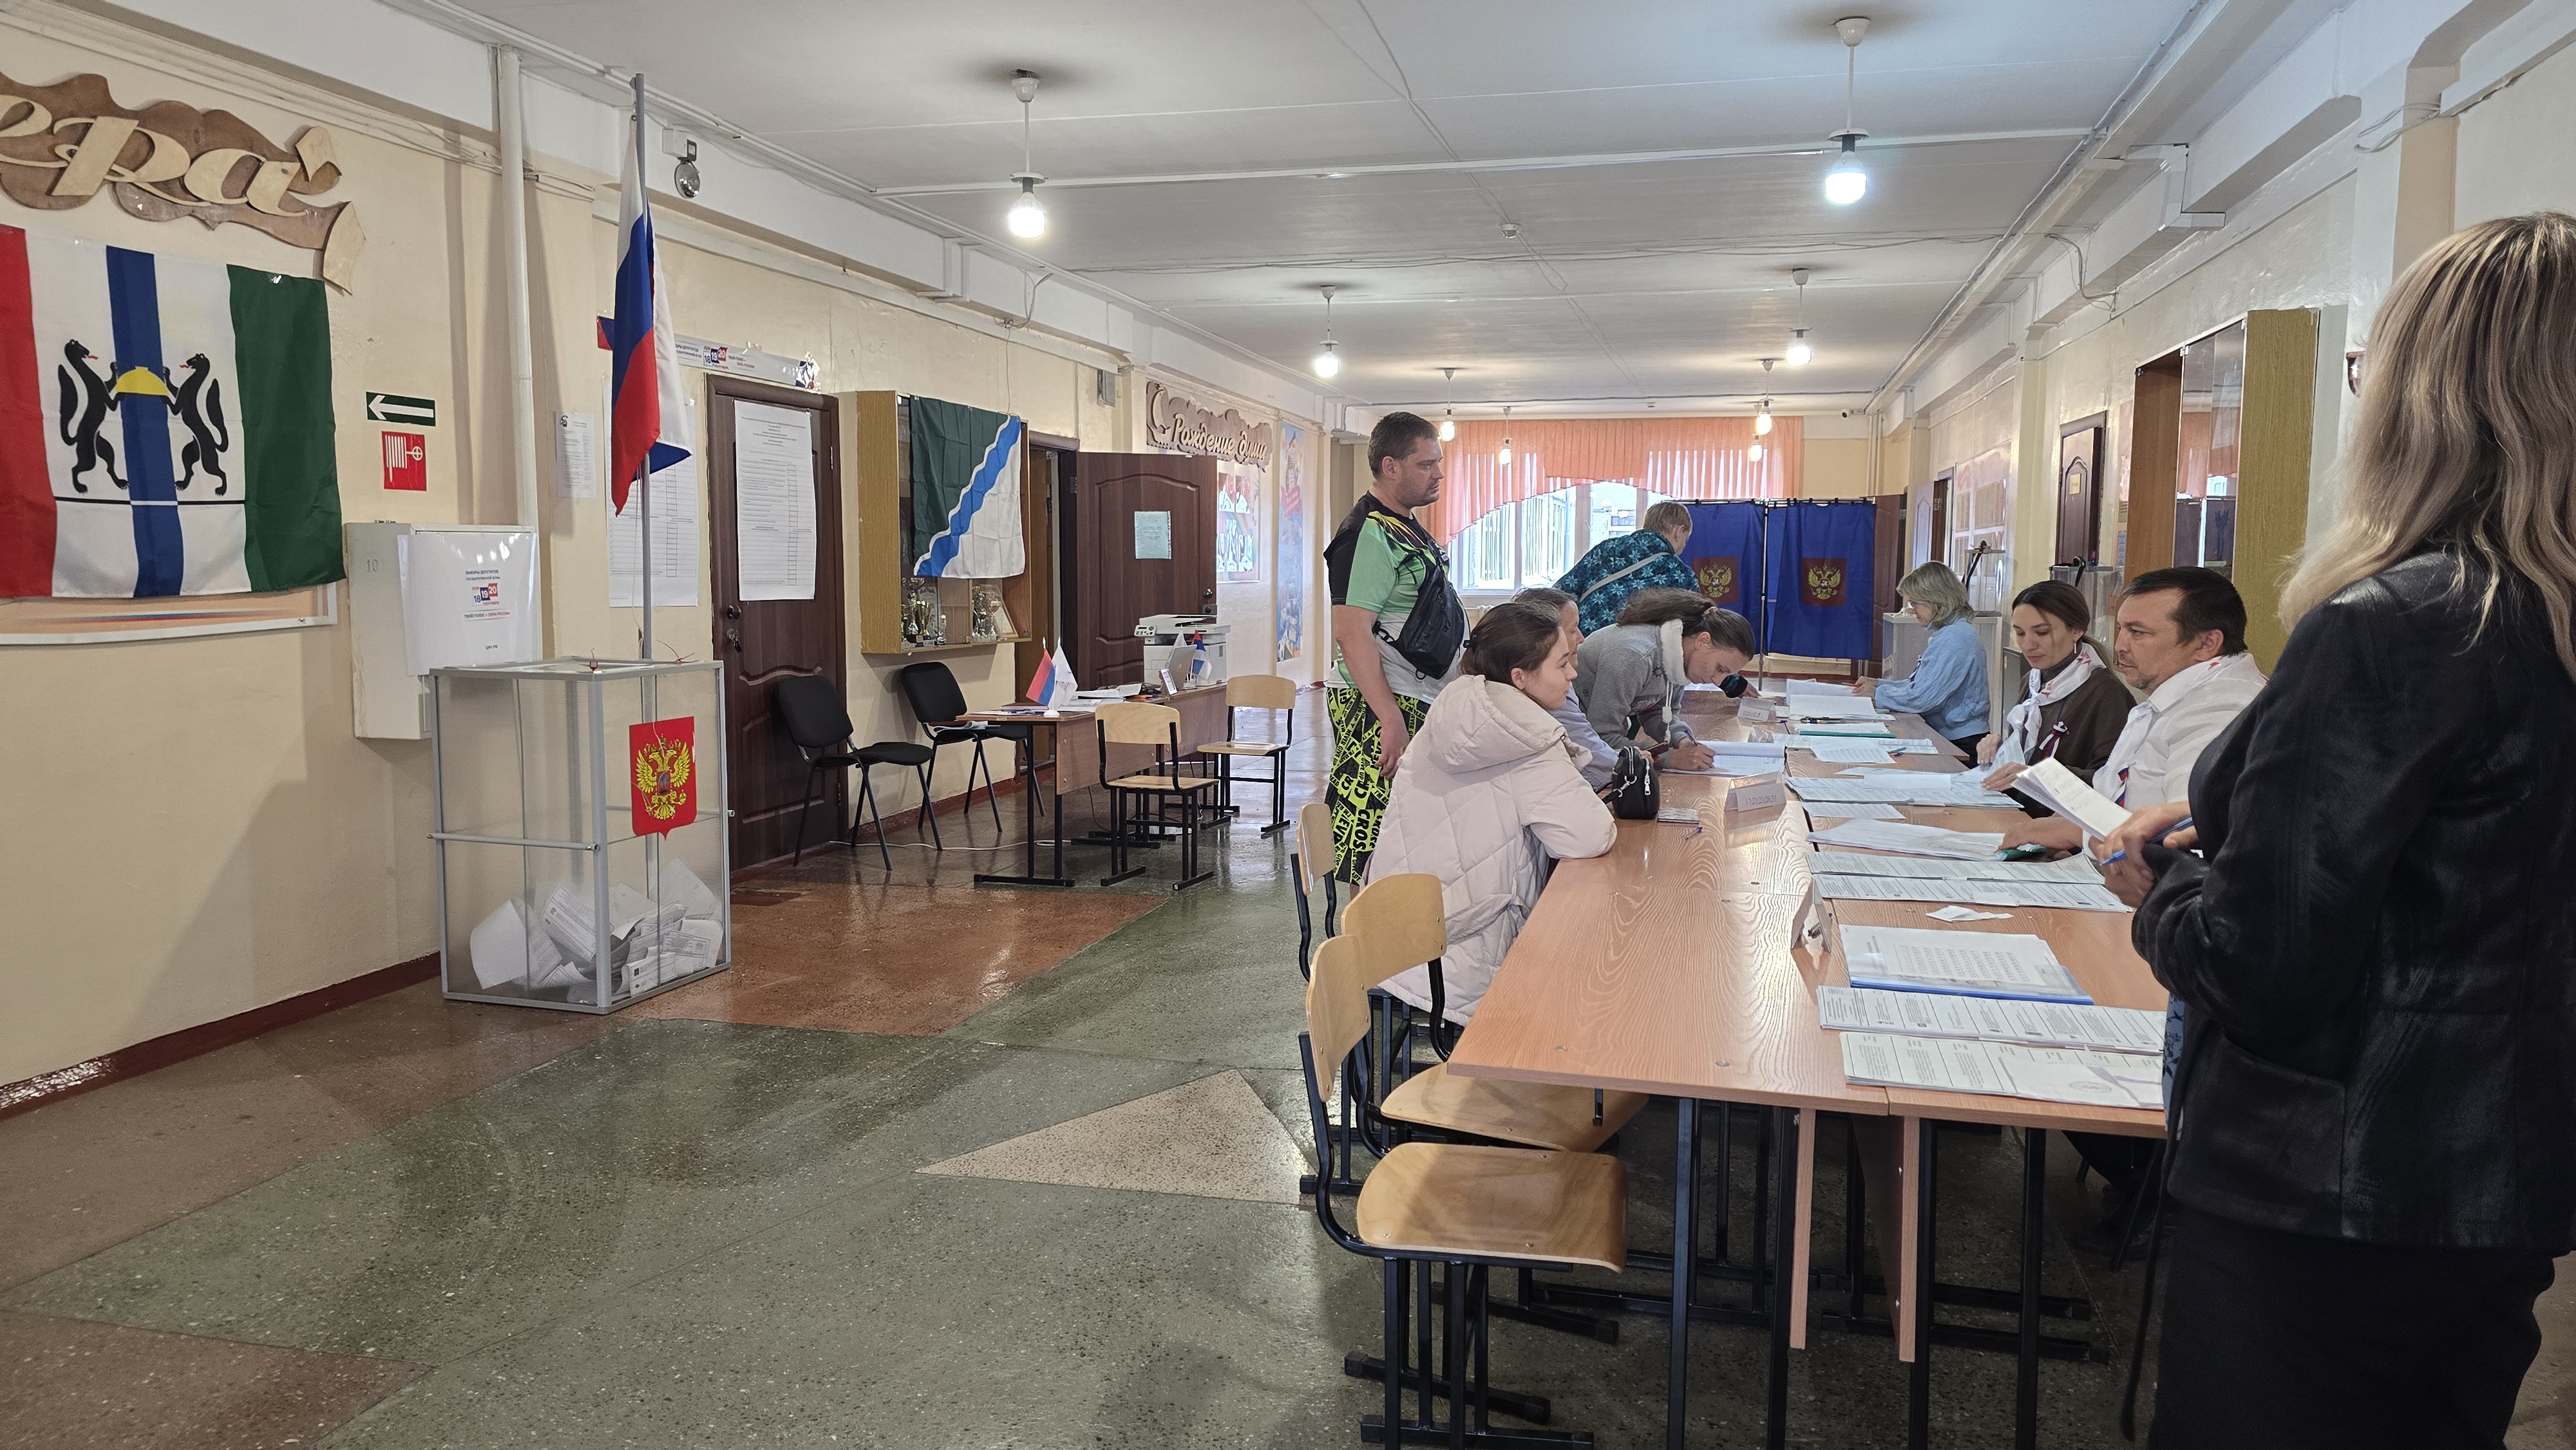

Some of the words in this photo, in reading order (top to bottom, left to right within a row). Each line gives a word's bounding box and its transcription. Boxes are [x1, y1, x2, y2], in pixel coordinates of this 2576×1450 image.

[704, 355, 711, 364] 18
[711, 351, 717, 361] 19
[717, 348, 726, 359] 20
[1172, 413, 1235, 455] Рождение
[1238, 430, 1267, 463] души
[473, 595, 481, 603] 18
[481, 590, 489, 599] 19
[488, 586, 497, 594] 20
[1341, 729, 1352, 746] NEVER
[1334, 746, 1343, 758] GIVE
